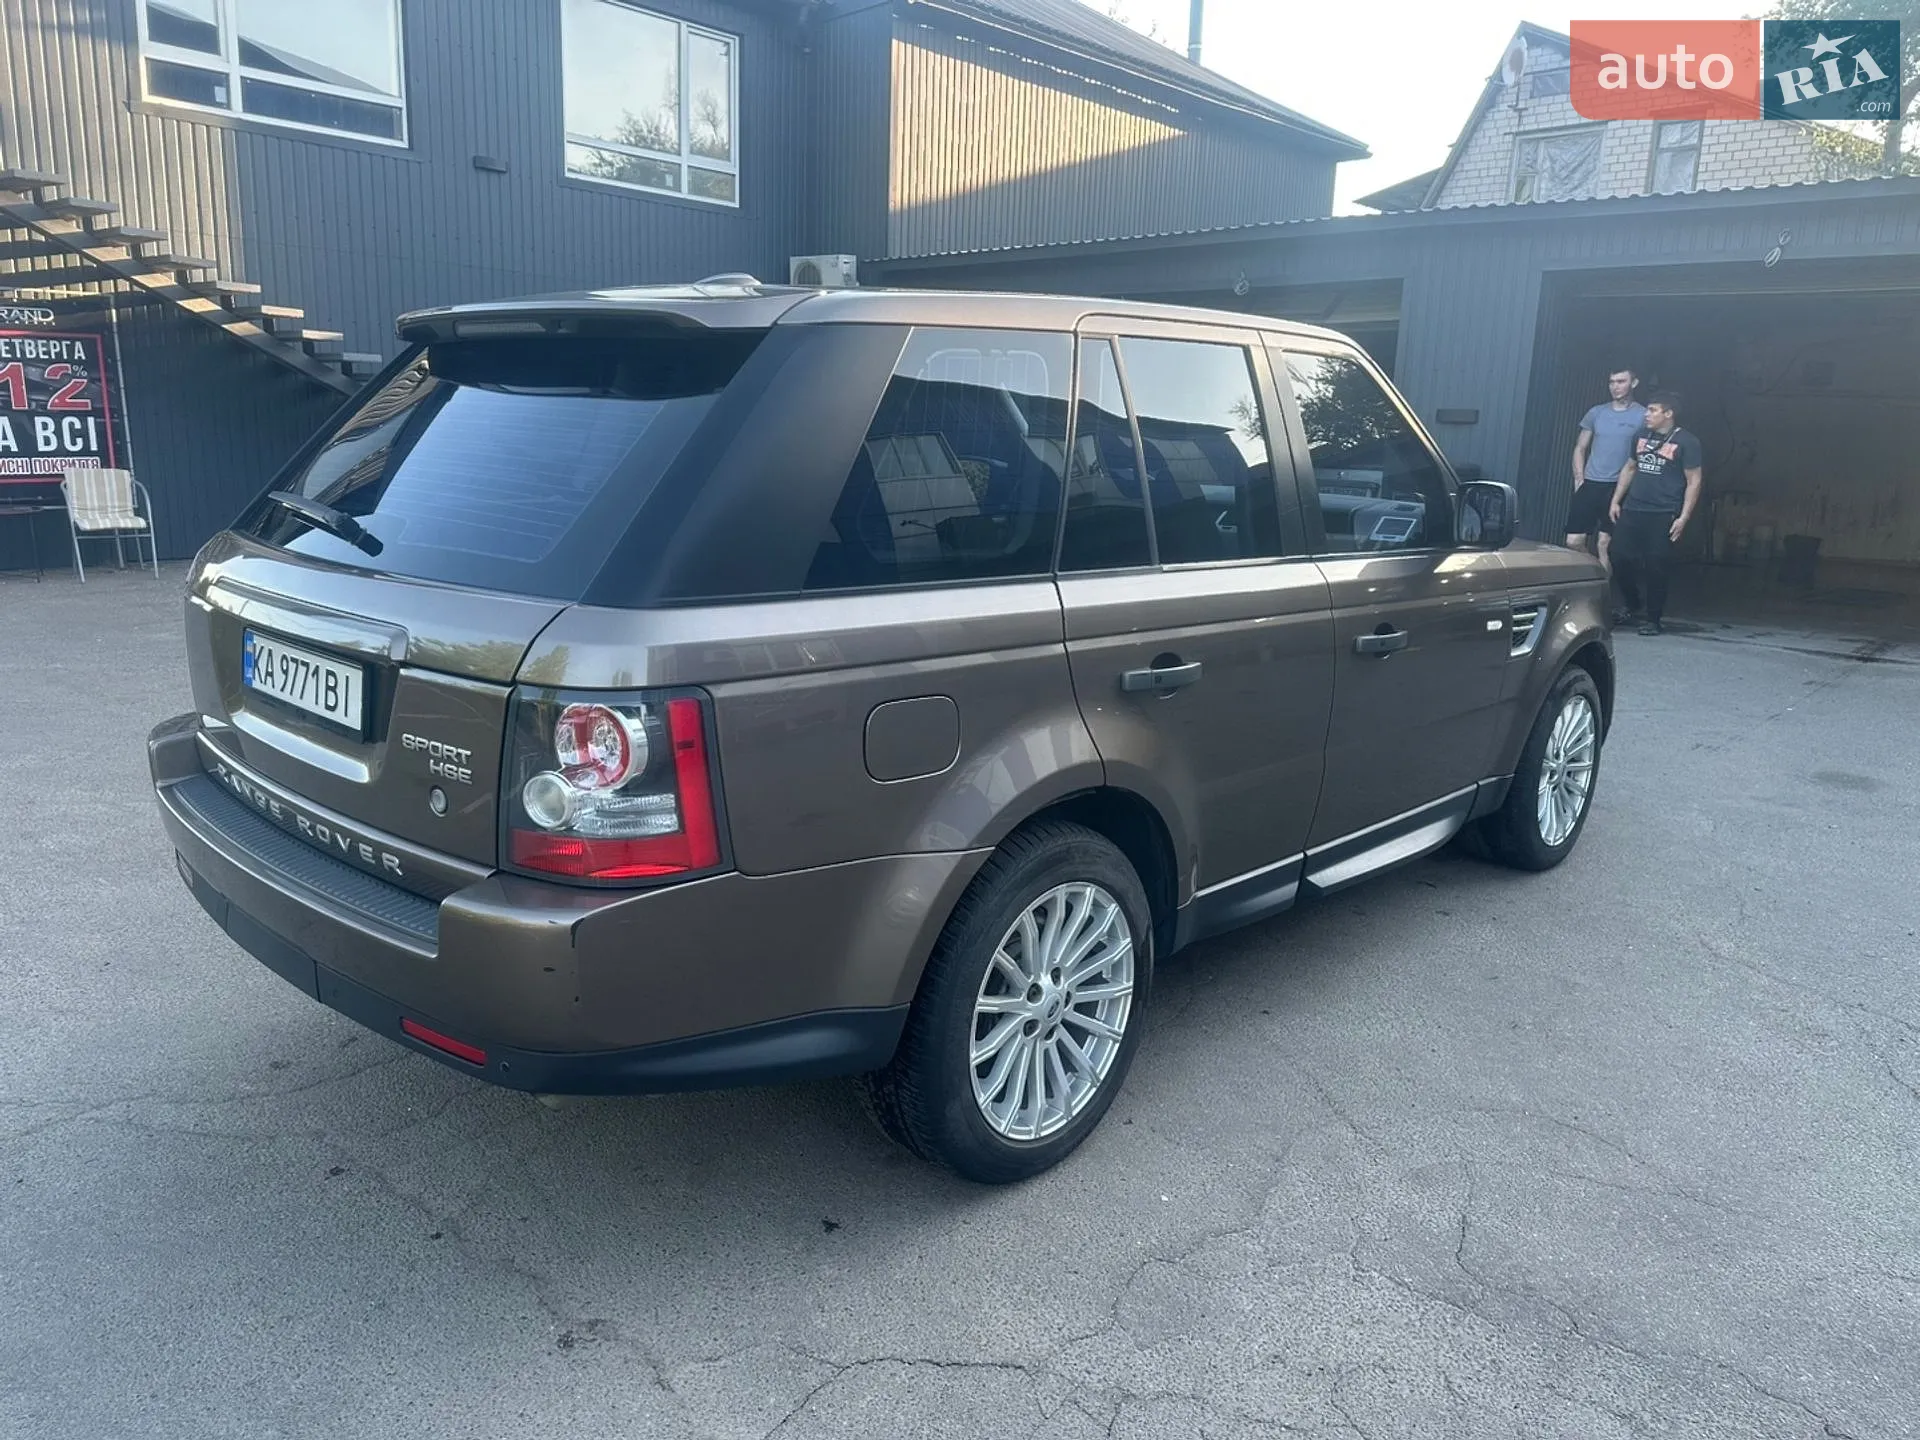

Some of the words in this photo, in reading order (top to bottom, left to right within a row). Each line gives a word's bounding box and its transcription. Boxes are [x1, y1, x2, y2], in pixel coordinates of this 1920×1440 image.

[35, 416, 98, 452] ВСІ
[402, 733, 471, 764] SPORT
[429, 759, 472, 785] HSE
[216, 763, 284, 821] RANGE
[296, 814, 403, 876] ROVER
